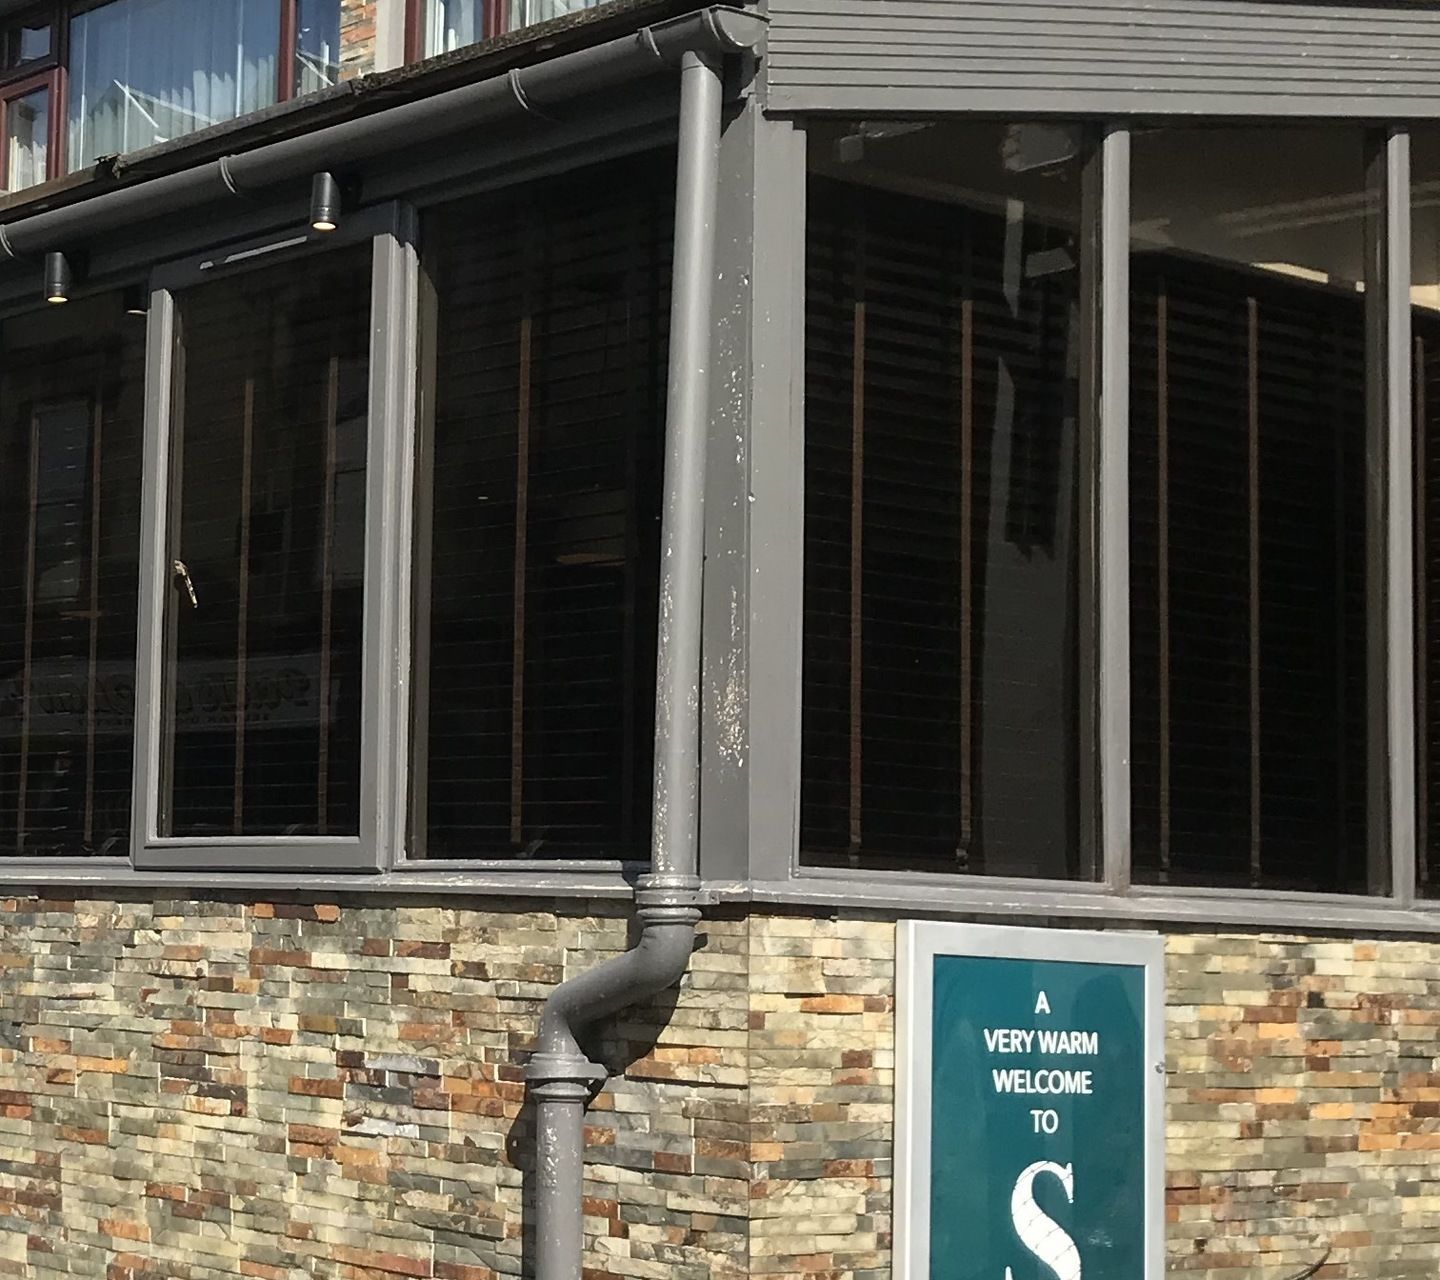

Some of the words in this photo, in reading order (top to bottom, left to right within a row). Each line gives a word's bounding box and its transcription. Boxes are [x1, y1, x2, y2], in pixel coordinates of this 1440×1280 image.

[1034, 990, 1052, 1015] A
[983, 1027, 1035, 1054] VERY
[1038, 1029, 1099, 1056] WARM
[992, 1068, 1094, 1095] WELCOME
[1029, 1108, 1060, 1135] TO
